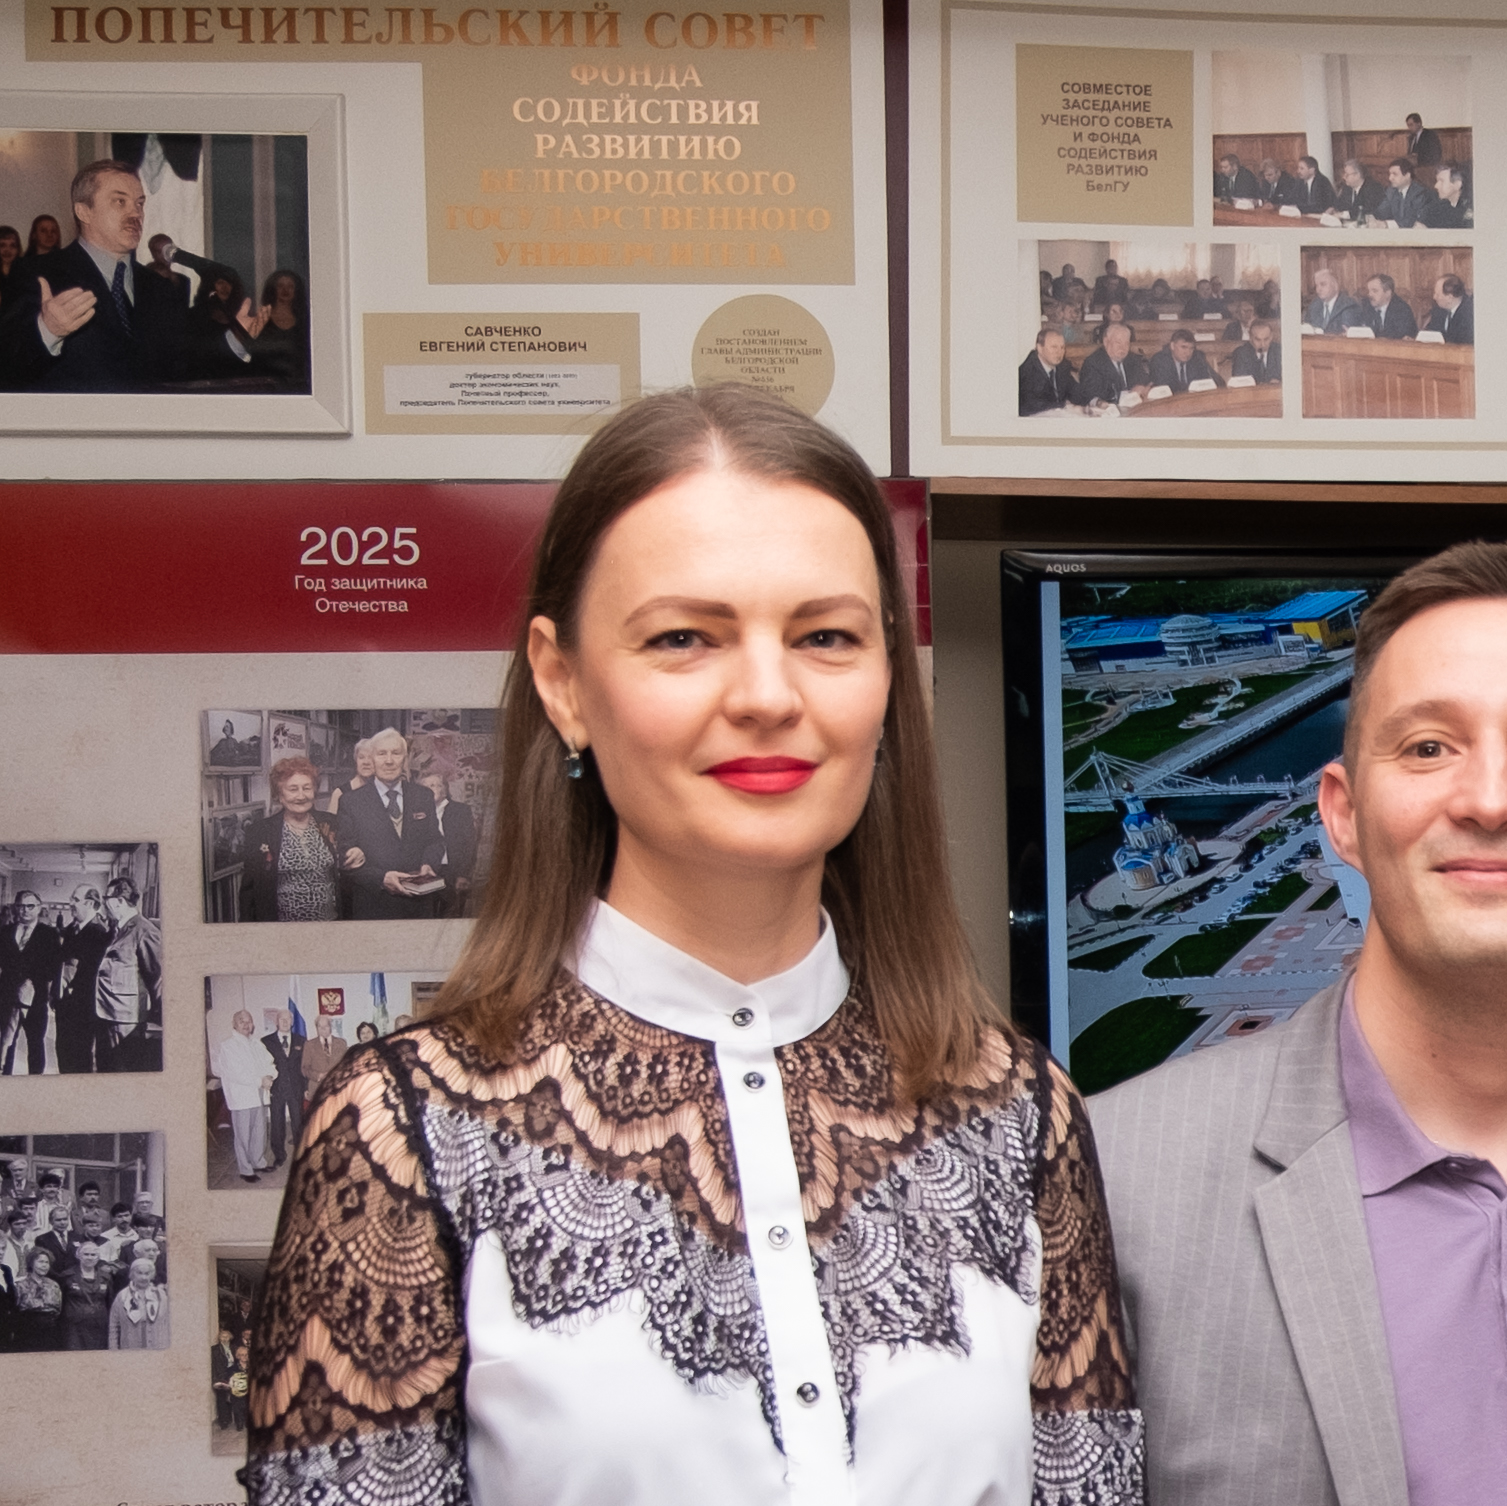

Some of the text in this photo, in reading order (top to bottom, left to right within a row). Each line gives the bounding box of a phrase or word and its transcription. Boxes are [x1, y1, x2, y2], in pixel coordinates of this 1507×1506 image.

[51, 3, 826, 51] ПОПЕЧИТЕЛЬСКИЙ СОВЕТ
[570, 63, 703, 91] ФОНДА
[1061, 82, 1152, 96] СОВМЕСТОЕ
[512, 93, 760, 127] СОДЕЙСТВИЯ
[1062, 99, 1151, 113] ЗАСЕДАНИЕ
[1041, 114, 1173, 129] УЧЕНОГО СОВЕТА
[1073, 132, 1141, 145] И ФОНДА
[535, 134, 742, 161] РАЗВИТИЮ
[1057, 145, 1158, 160] СОДЕЙСТВИЯ
[1067, 164, 1148, 176] РАЗВИТИЮ
[480, 169, 797, 198] БЕЛГОРОДСКОГО
[1086, 180, 1130, 192] БелГУ
[446, 205, 831, 233] ГОСУДАРСТВЕННОГО
[493, 241, 787, 269] УНИВЕРСИТЕТА
[464, 326, 542, 337] САВЧЕНКО
[420, 339, 587, 352] ЕВГЕНИЙ СТЕПАНОВИЧ
[300, 526, 420, 566] 2025
[1046, 564, 1086, 574] AQUOS
[295, 575, 428, 592] Год защитника
[315, 597, 408, 613] Отечества
